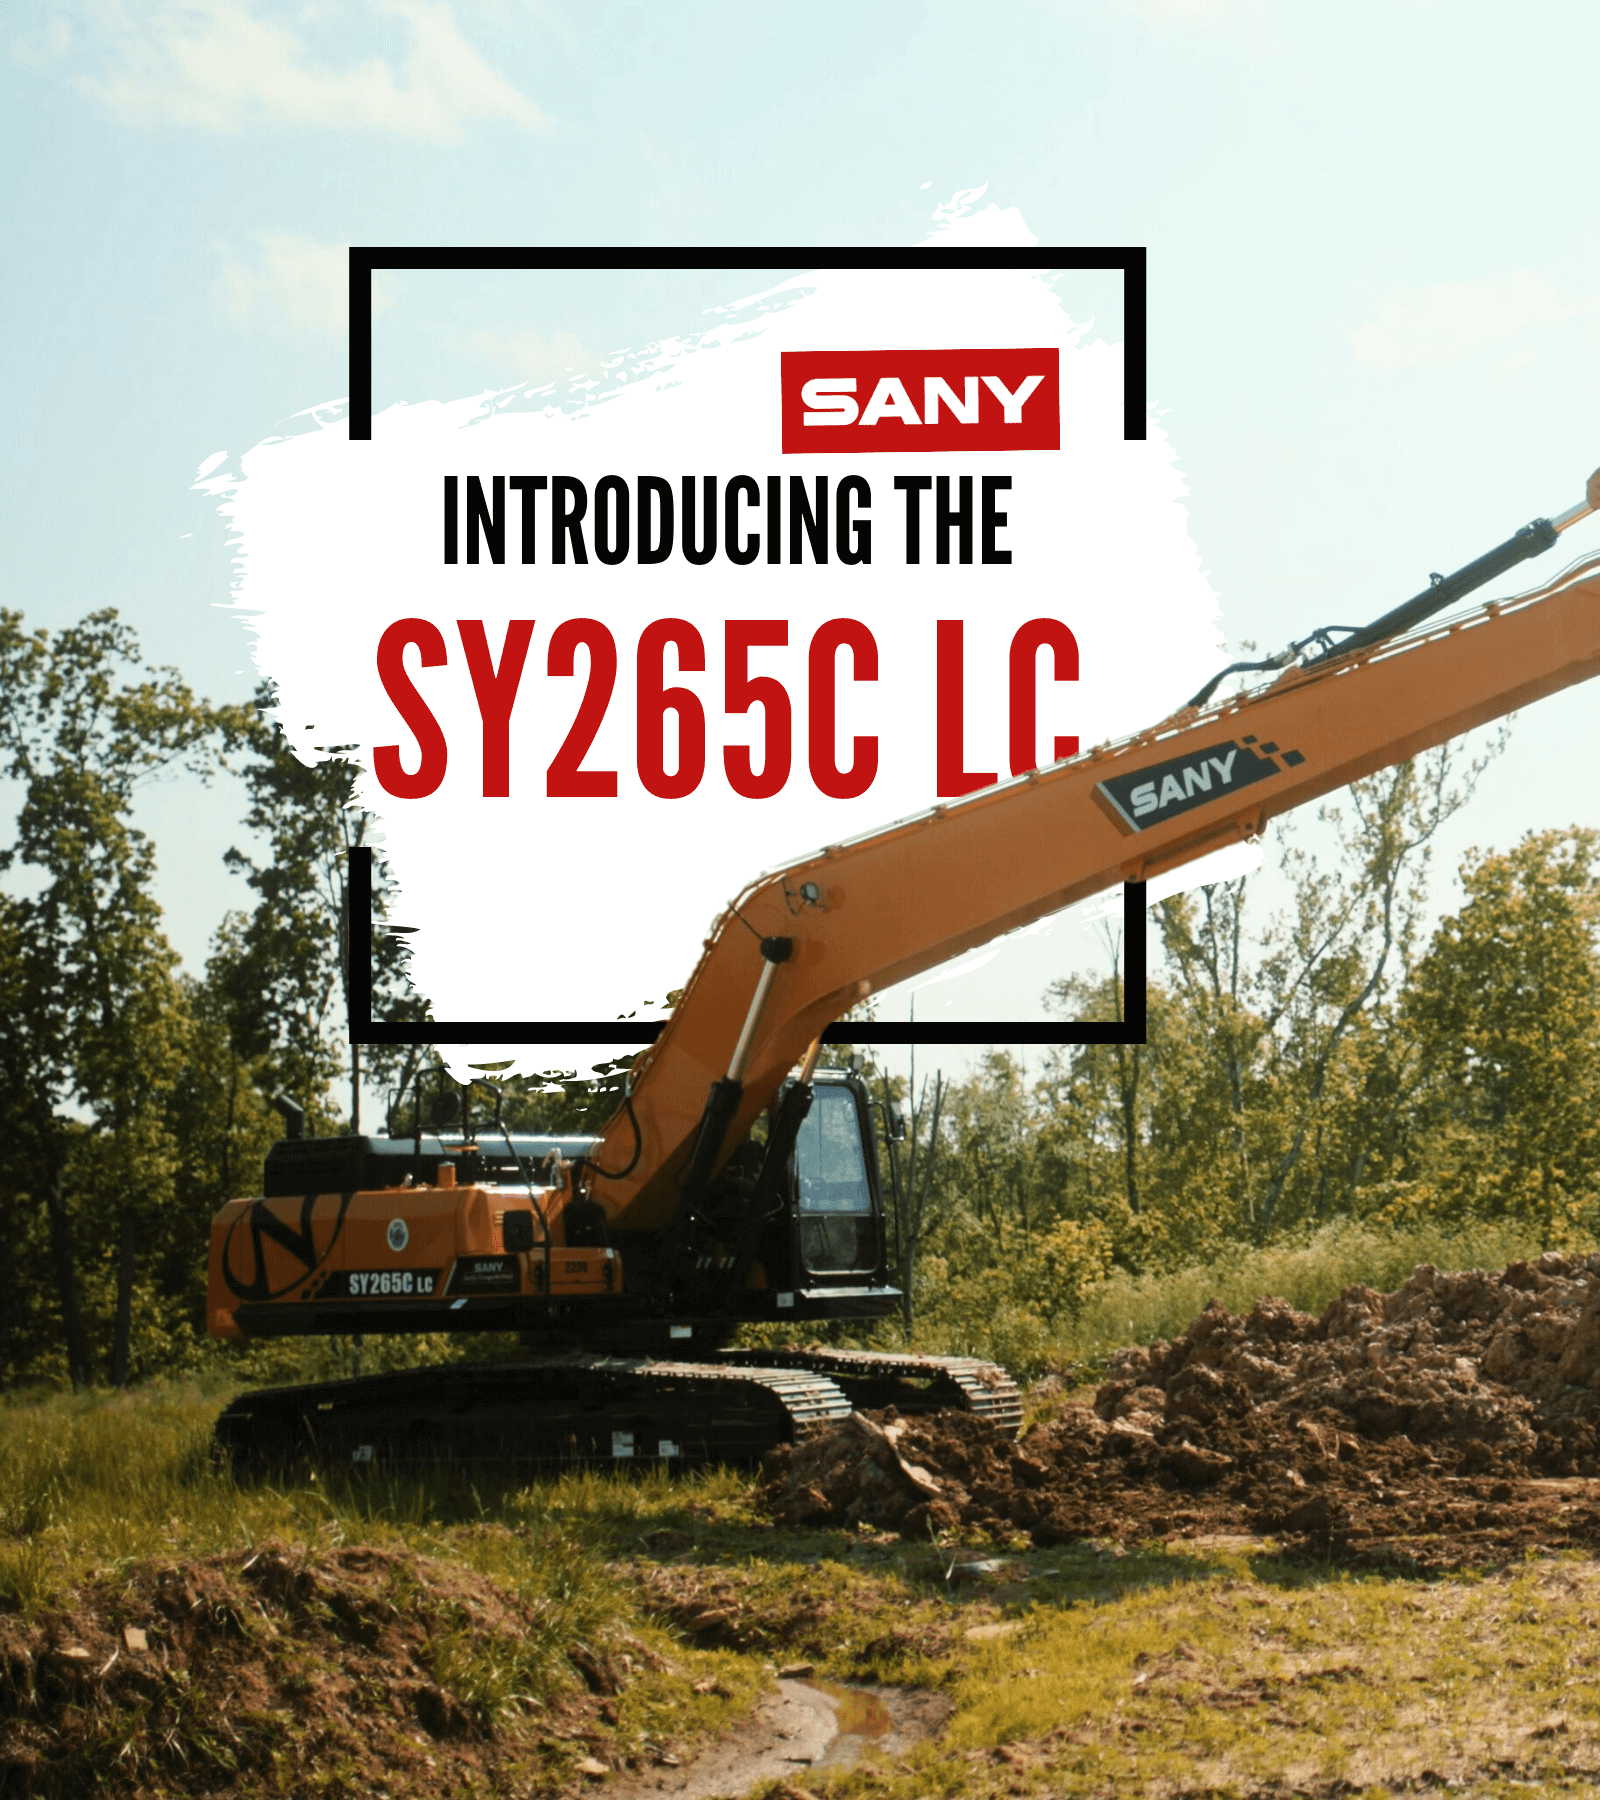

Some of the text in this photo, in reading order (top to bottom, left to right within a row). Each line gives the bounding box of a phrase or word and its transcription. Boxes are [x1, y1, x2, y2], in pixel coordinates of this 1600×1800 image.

[1129, 749, 1237, 818] SANY
[350, 1272, 433, 1294] SY265C LC
